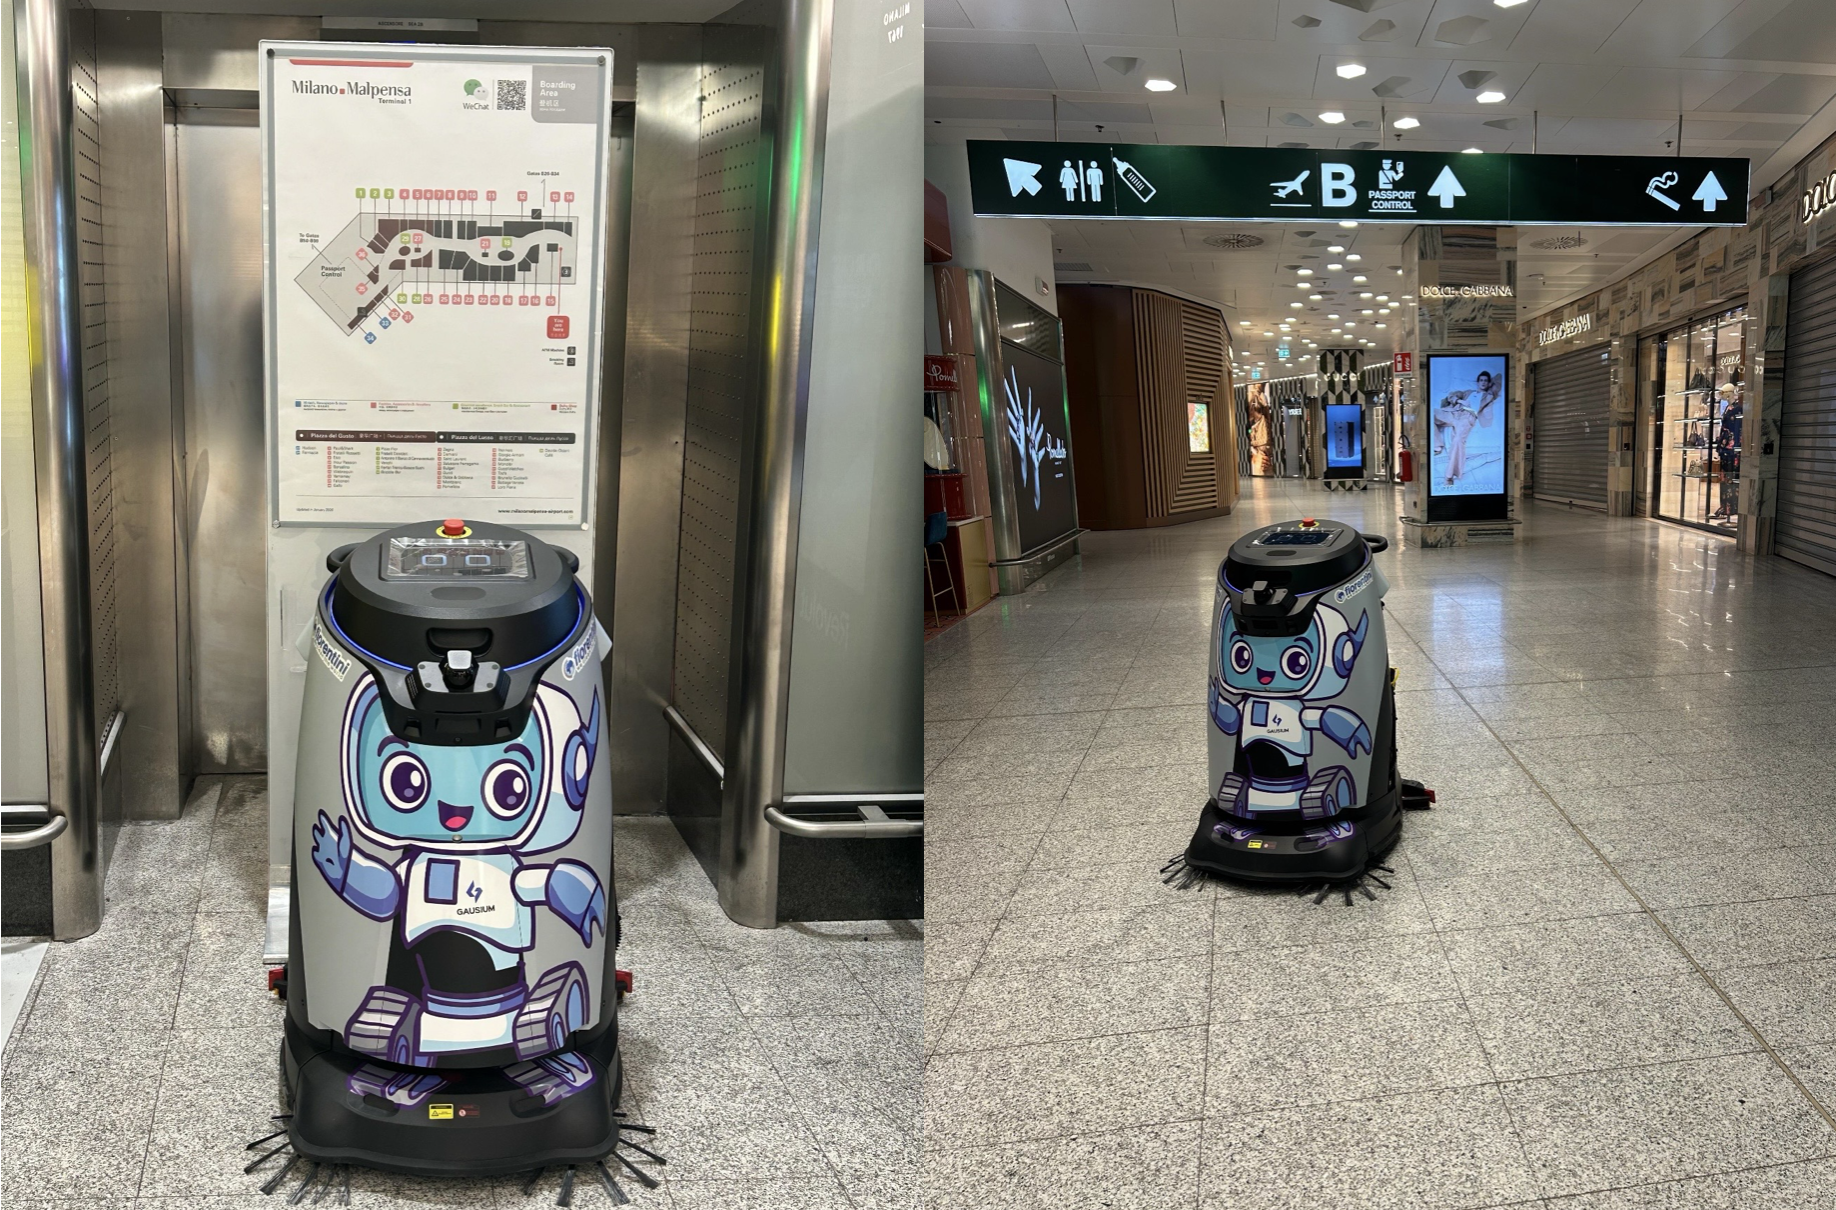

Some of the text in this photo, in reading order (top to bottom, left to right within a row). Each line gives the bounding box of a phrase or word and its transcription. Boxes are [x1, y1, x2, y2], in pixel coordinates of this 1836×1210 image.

[292, 80, 411, 99] Milano Malpensa
[540, 81, 576, 90] Boarding
[1321, 162, 1357, 207] B
[1368, 190, 1416, 200] PASSPORT
[1372, 200, 1413, 209] CONTROL
[1421, 286, 1514, 297] DOLCE GABBANA
[1324, 372, 1360, 381] GUCCI
[457, 905, 495, 916] GAUSIUM
